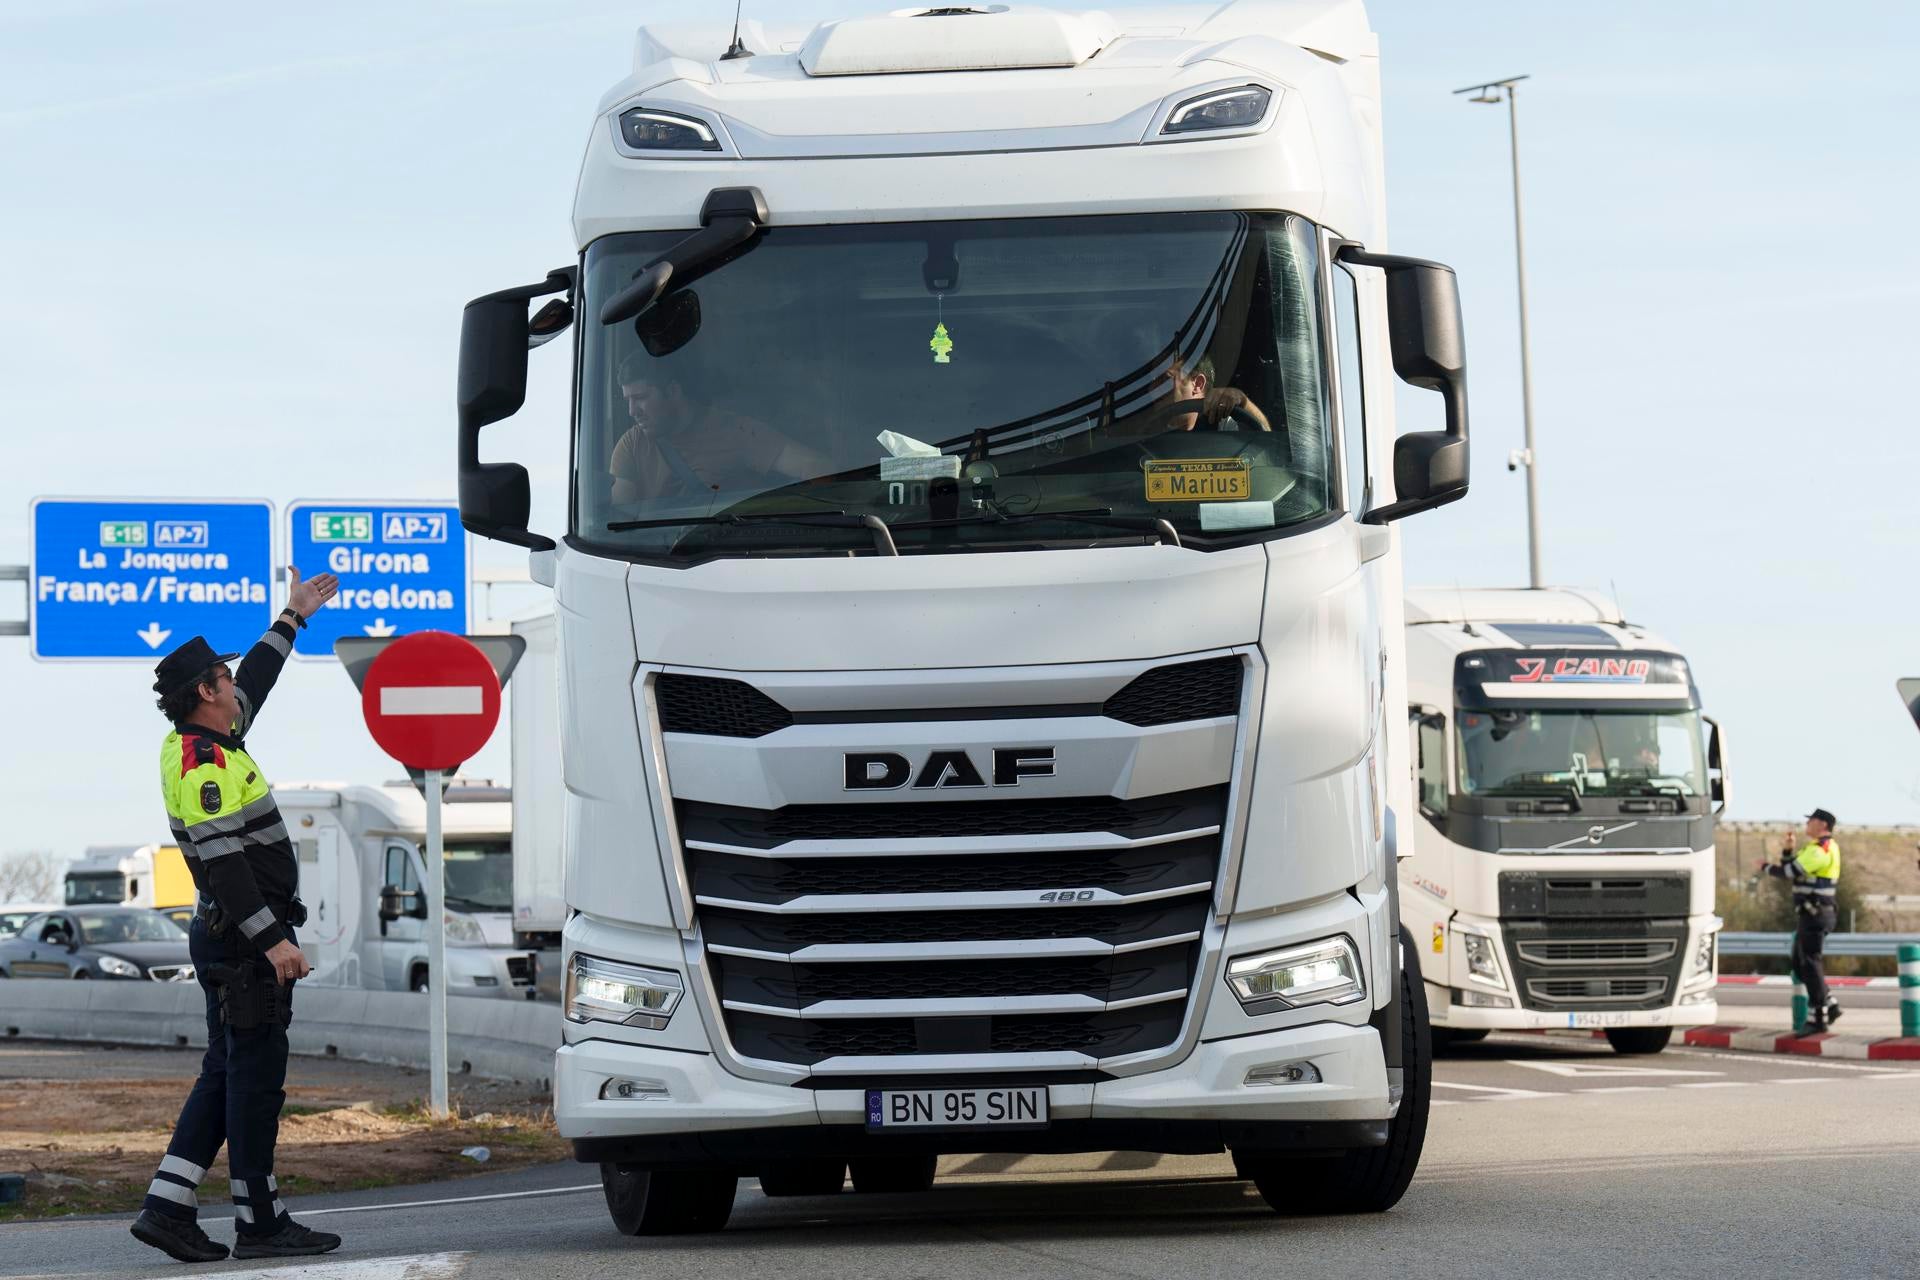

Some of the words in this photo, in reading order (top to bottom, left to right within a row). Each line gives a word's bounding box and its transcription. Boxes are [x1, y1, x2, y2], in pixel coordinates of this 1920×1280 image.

[1181, 464, 1213, 472] TEXAS
[1170, 473, 1238, 495] Marius
[103, 526, 144, 542] E-15
[159, 526, 204, 543] AP-7
[315, 517, 368, 538] E-15
[387, 517, 442, 538] AP-7
[79, 548, 107, 570] La
[119, 548, 229, 573] Jonquera
[328, 546, 430, 574] Girona
[322, 583, 454, 610] arcelona
[843, 746, 1056, 791] DAF
[1039, 890, 1095, 902] 480
[871, 1113, 881, 1122] RO
[891, 1093, 933, 1122] BN
[944, 1092, 977, 1121] 95
[986, 1091, 1037, 1120] SIN
